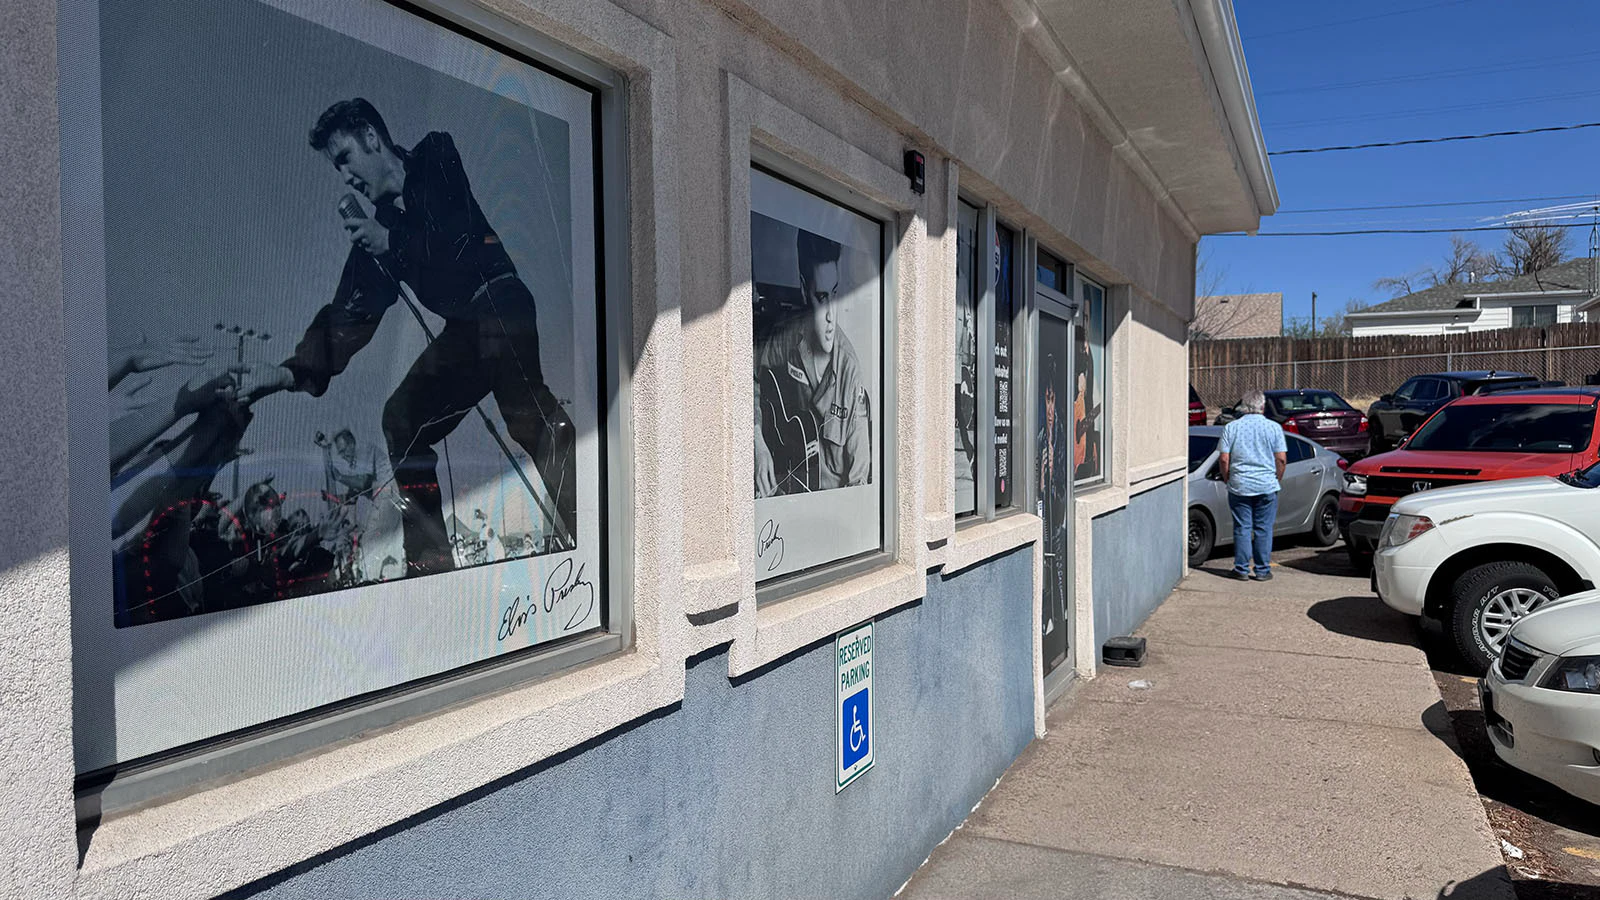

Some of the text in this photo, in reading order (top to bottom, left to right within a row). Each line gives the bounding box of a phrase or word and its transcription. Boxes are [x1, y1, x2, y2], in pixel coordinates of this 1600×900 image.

[498, 557, 594, 641] Elvis Presley
[839, 635, 872, 666] RESERVED
[841, 660, 870, 692] PARKING
